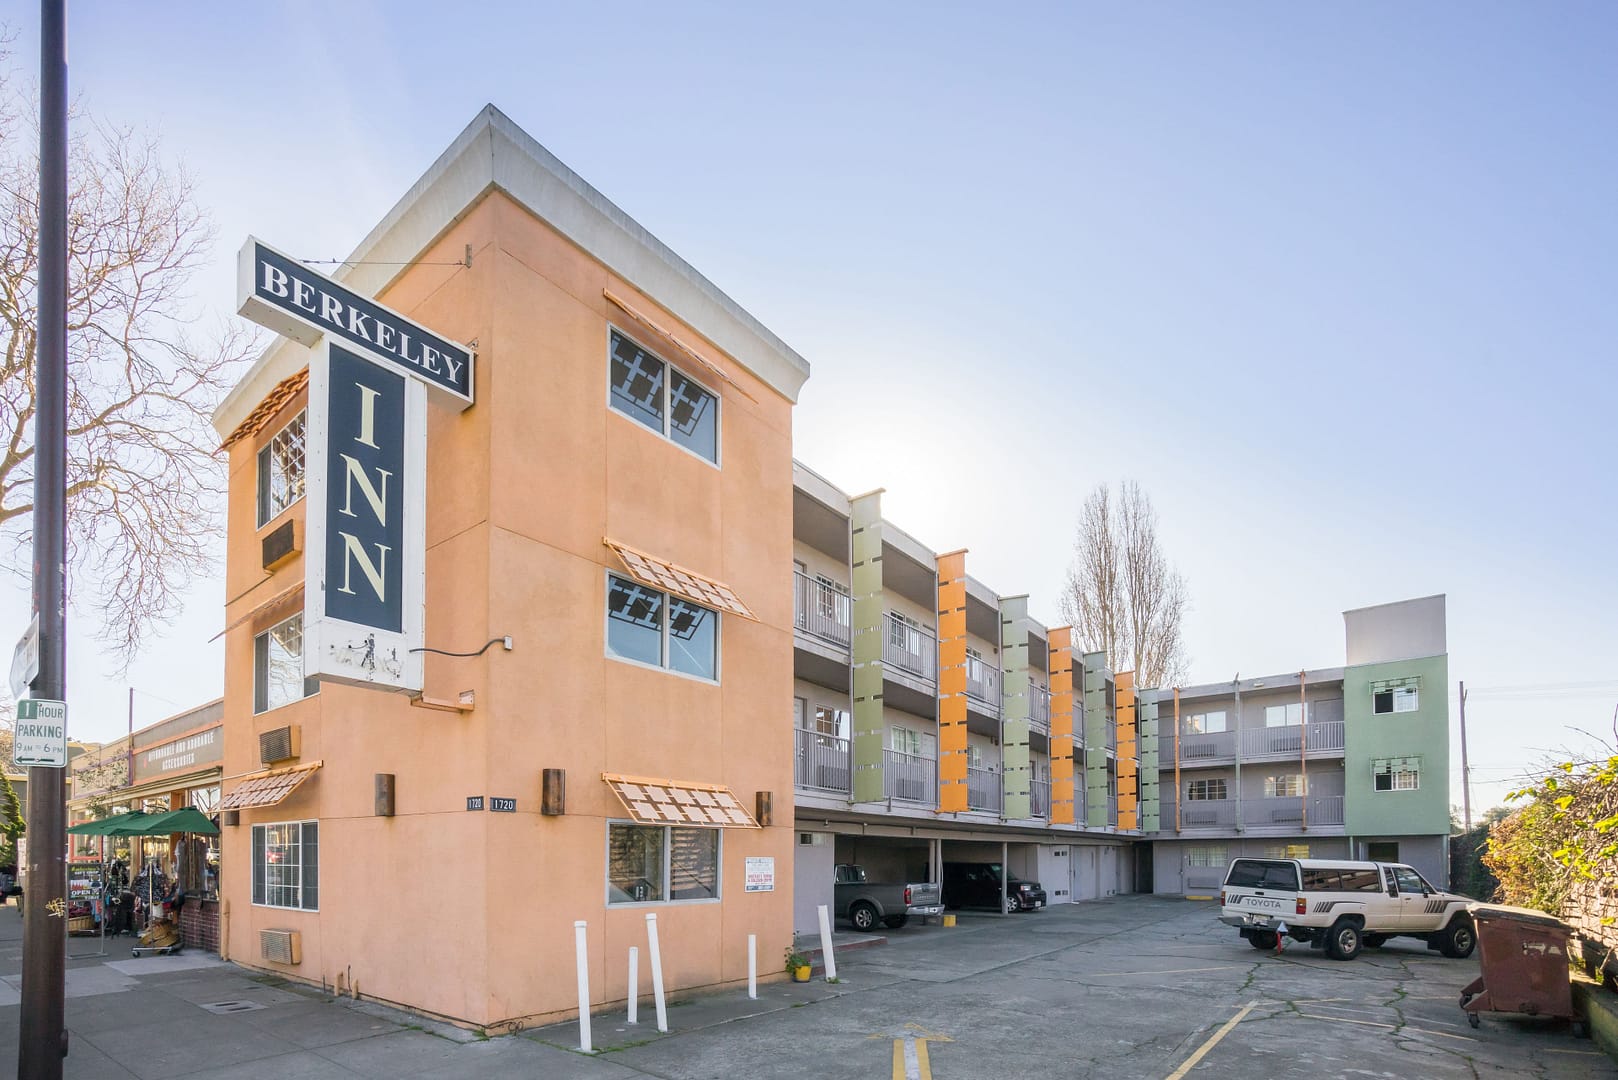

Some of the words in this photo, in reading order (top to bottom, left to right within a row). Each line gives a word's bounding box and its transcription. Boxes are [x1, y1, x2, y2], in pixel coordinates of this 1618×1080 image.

[260, 260, 463, 385] BERKELEY
[337, 381, 393, 603] INN
[26, 703, 30, 717] 1
[38, 707, 63, 719] HOUR
[18, 724, 62, 738] PARKING
[16, 742, 23, 752] 9
[23, 745, 33, 753] AM
[43, 743, 51, 753] 6
[468, 798, 482, 809] 1720
[495, 799, 513, 809] 1720
[1246, 898, 1281, 908] TOYOTA
